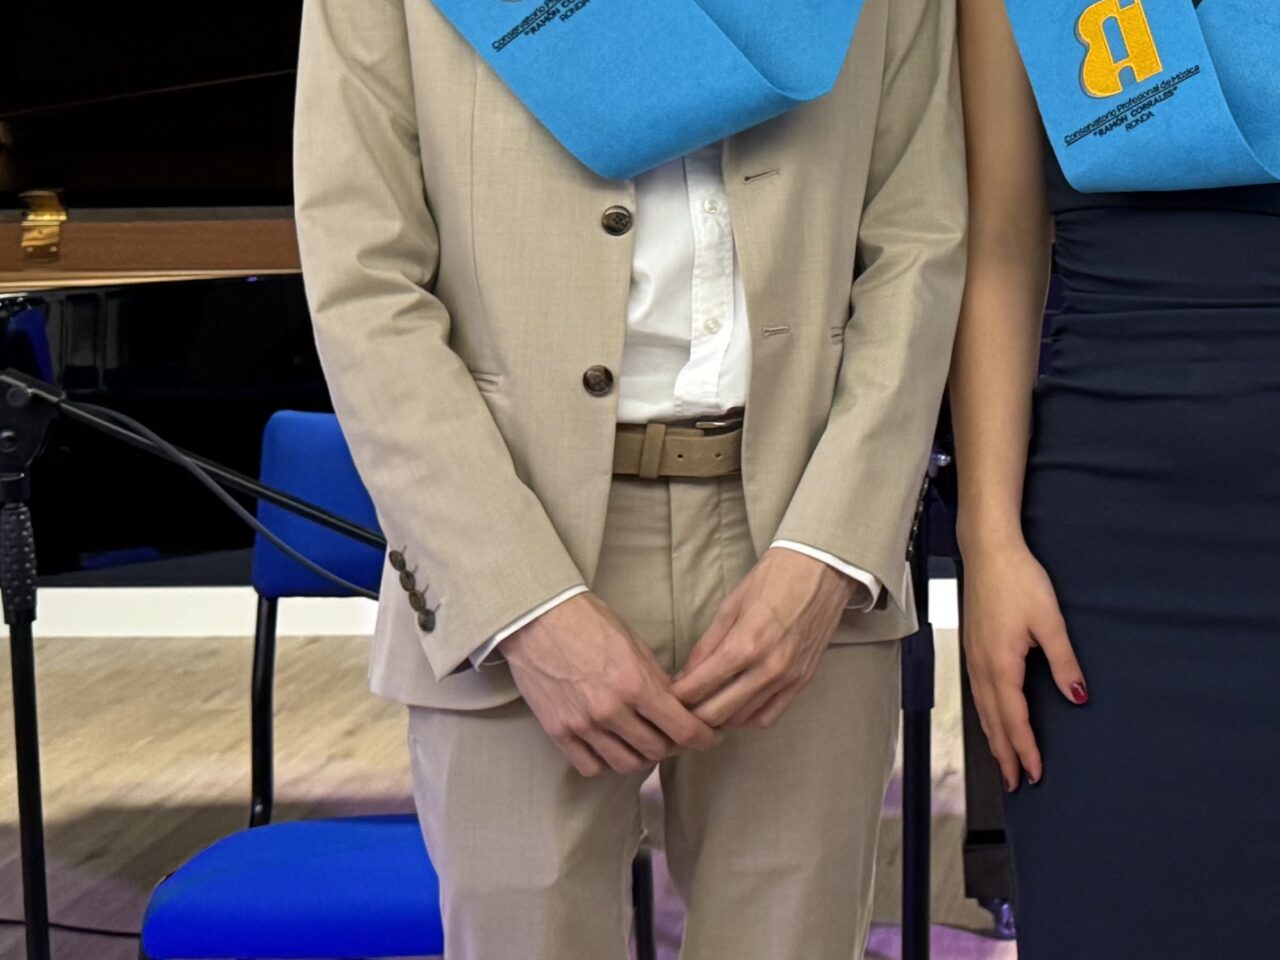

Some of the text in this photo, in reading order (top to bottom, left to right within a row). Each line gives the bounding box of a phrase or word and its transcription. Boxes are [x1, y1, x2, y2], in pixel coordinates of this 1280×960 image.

[1064, 109, 1119, 145] Conservatorio
[1116, 84, 1160, 113] Profesional
[1124, 110, 1155, 132] RONDA
